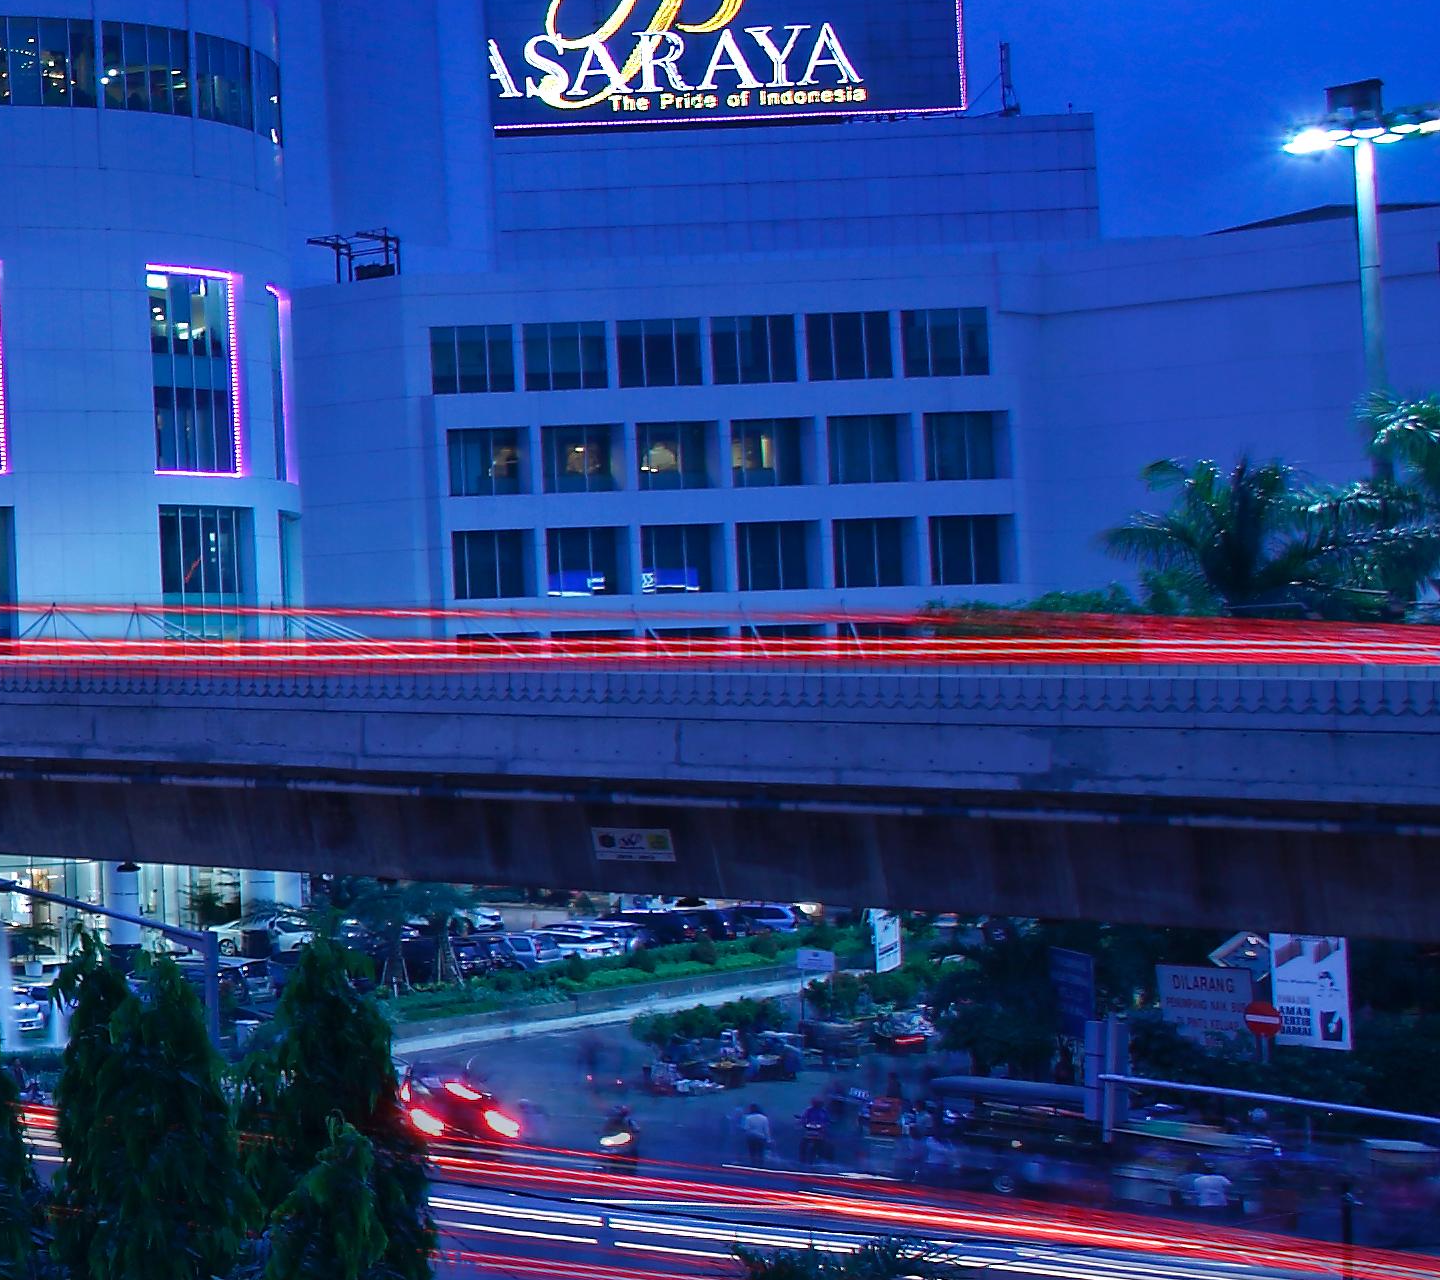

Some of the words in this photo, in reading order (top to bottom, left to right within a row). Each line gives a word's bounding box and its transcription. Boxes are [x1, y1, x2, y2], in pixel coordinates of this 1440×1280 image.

[609, 93, 650, 112] The
[727, 90, 749, 108] of
[759, 86, 868, 107] Indonesia
[1171, 974, 1235, 993] DILARANG
